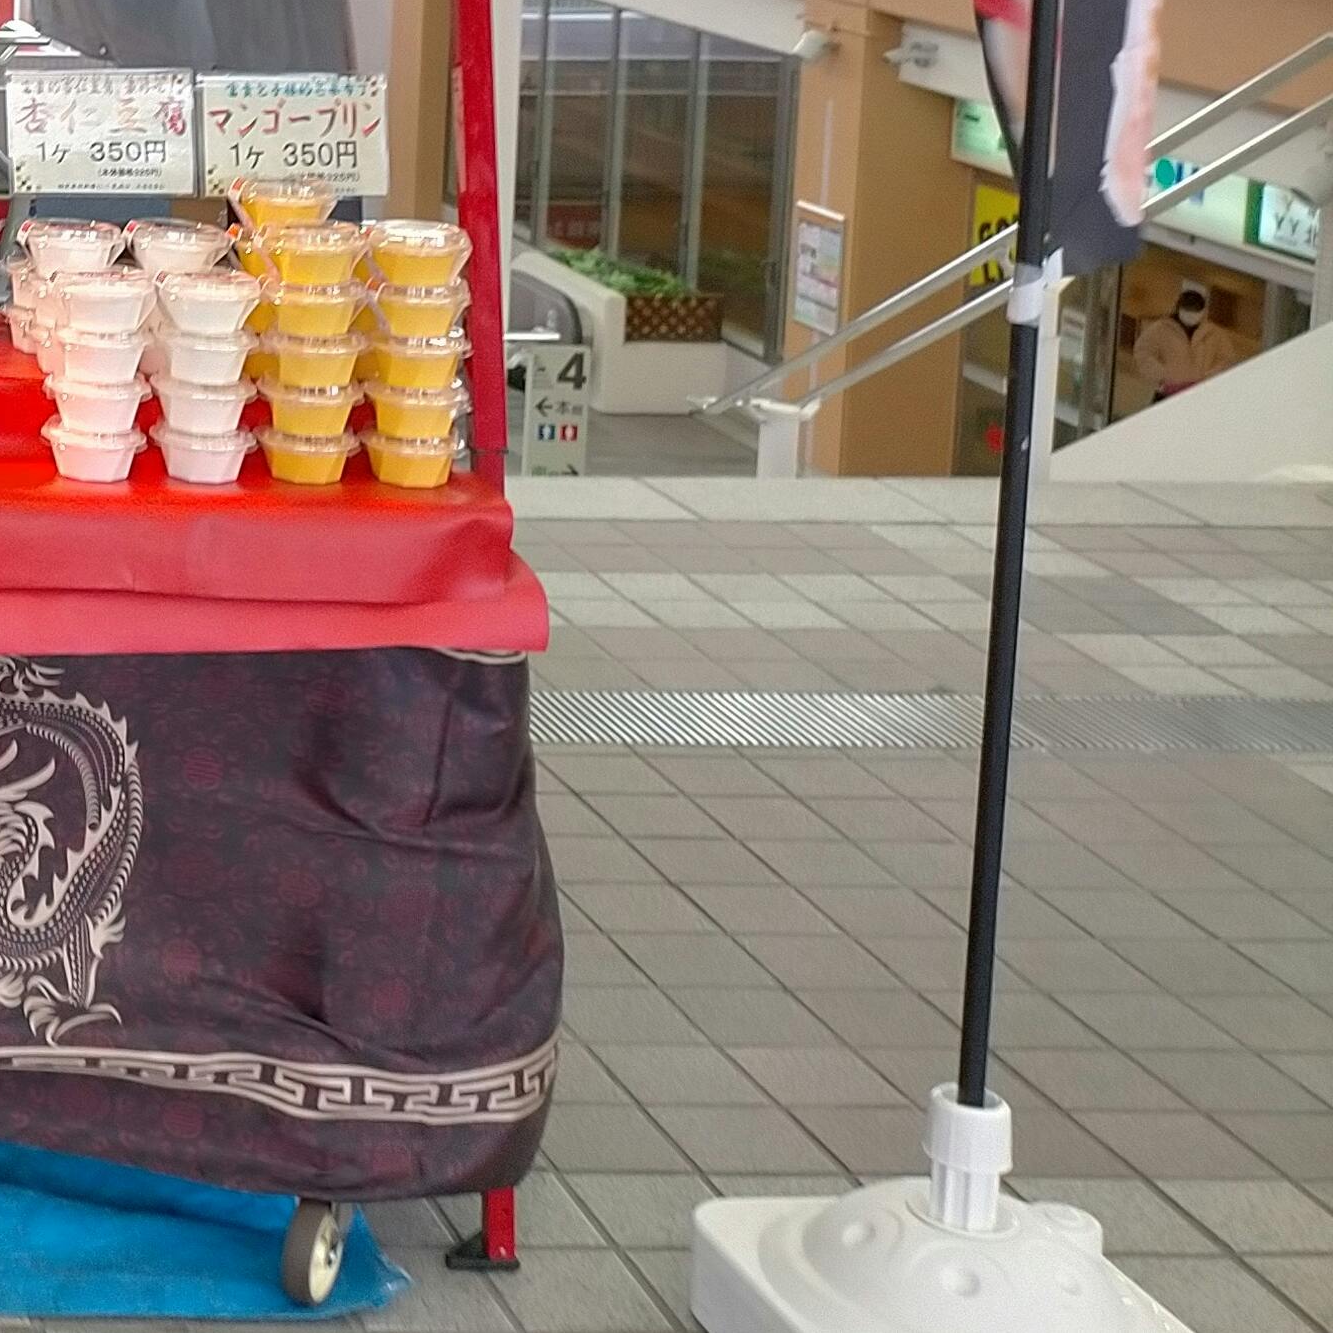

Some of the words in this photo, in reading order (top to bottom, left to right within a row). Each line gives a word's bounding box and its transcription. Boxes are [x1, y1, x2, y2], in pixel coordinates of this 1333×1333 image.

[16, 97, 188, 136] 杏仁豆腐
[207, 98, 382, 138] マンゴープリン
[36, 142, 71, 164] 1ケ
[90, 140, 167, 163] 350円
[229, 142, 265, 169] 1ケ
[282, 140, 358, 169] 350円
[557, 352, 587, 389] 4
